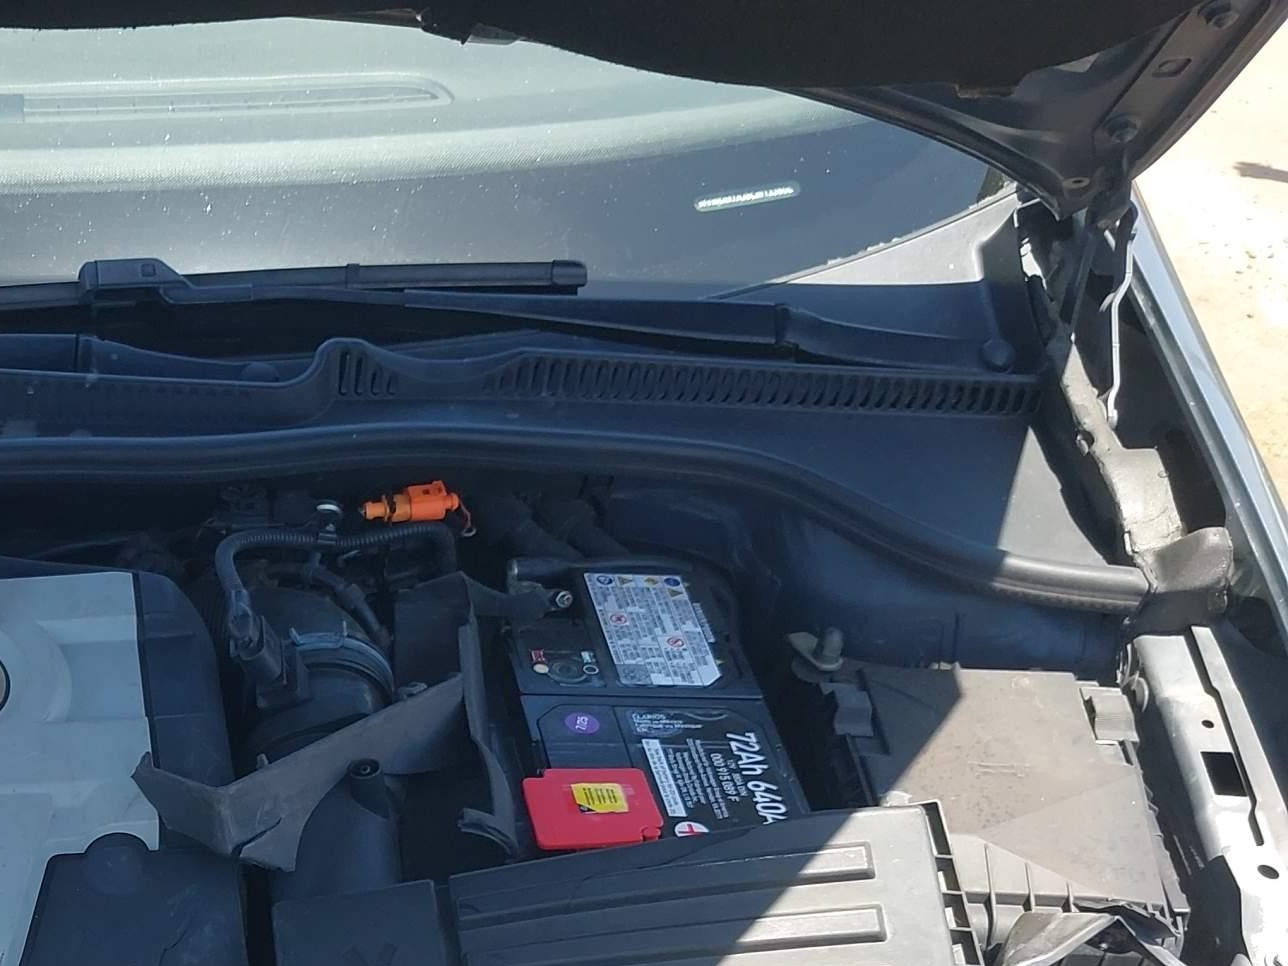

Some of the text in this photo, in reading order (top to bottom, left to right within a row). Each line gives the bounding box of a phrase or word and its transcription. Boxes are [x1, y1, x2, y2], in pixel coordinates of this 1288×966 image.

[710, 752, 726, 767] 000
[715, 767, 731, 781] 915
[726, 732, 789, 825] 72Ah 640A
[722, 781, 738, 795] 089
